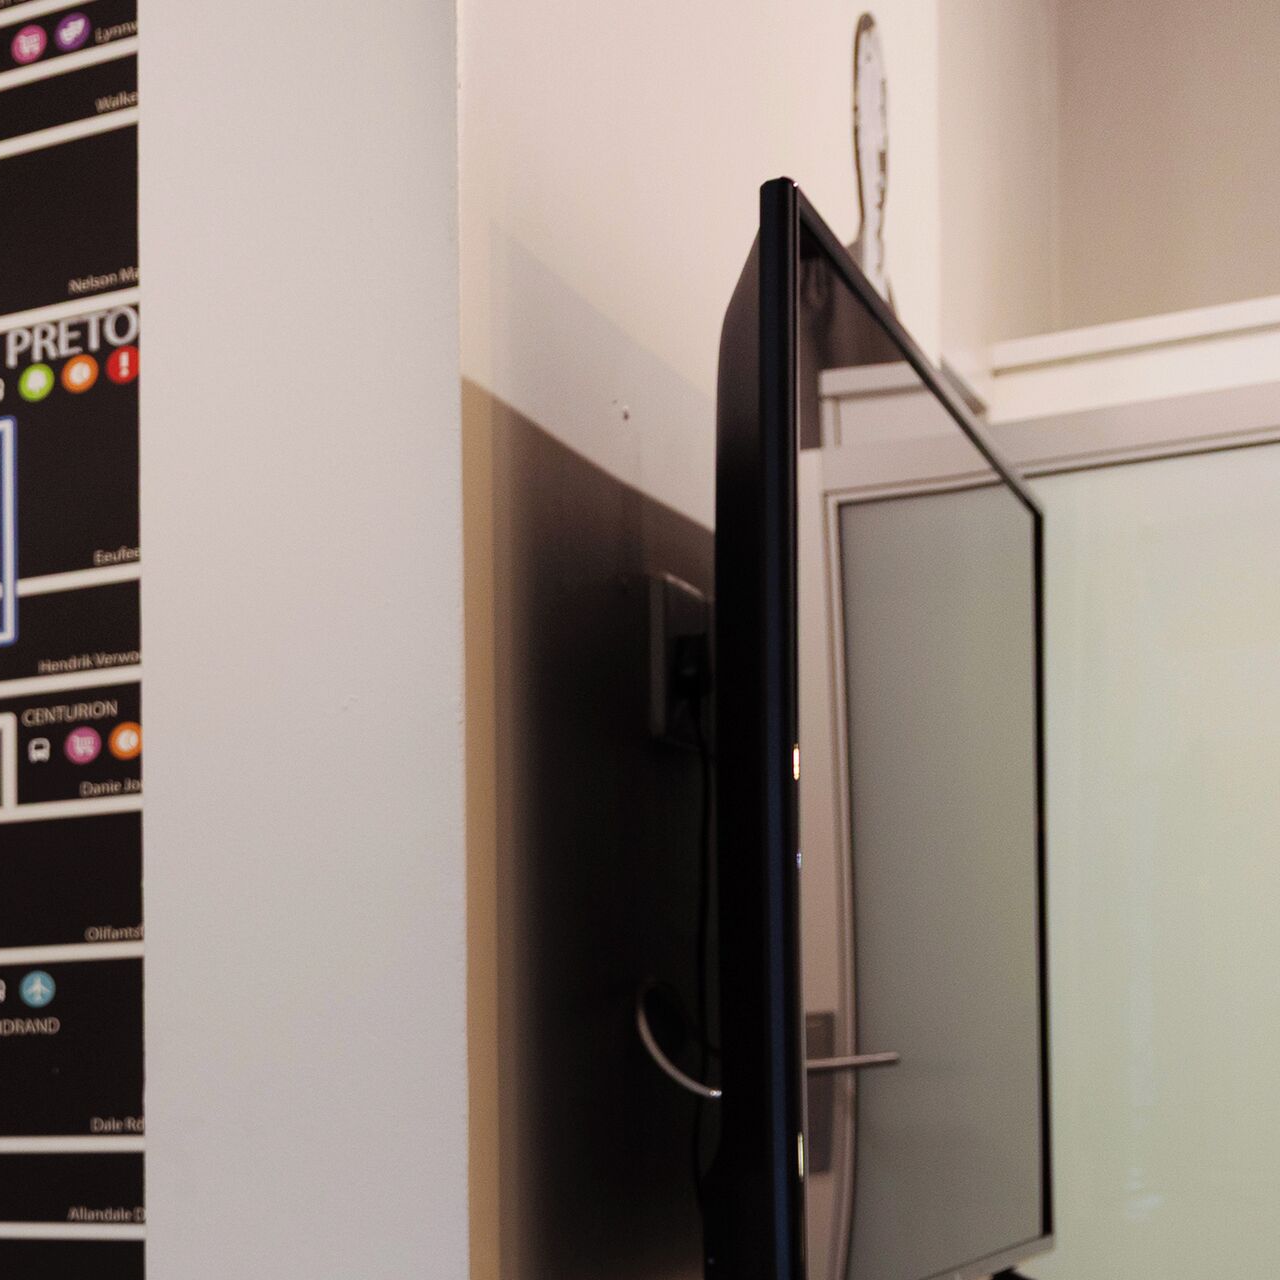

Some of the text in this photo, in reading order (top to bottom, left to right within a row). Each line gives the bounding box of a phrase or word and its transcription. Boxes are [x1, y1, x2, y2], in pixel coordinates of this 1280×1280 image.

[68, 271, 118, 294] Nelson
[5, 305, 138, 369] PRETO
[38, 653, 93, 673] Hendrik
[21, 700, 118, 727] CENTURION
[79, 780, 122, 798] Danie
[90, 1117, 123, 1133] Dale
[67, 1206, 133, 1221] Allandale
